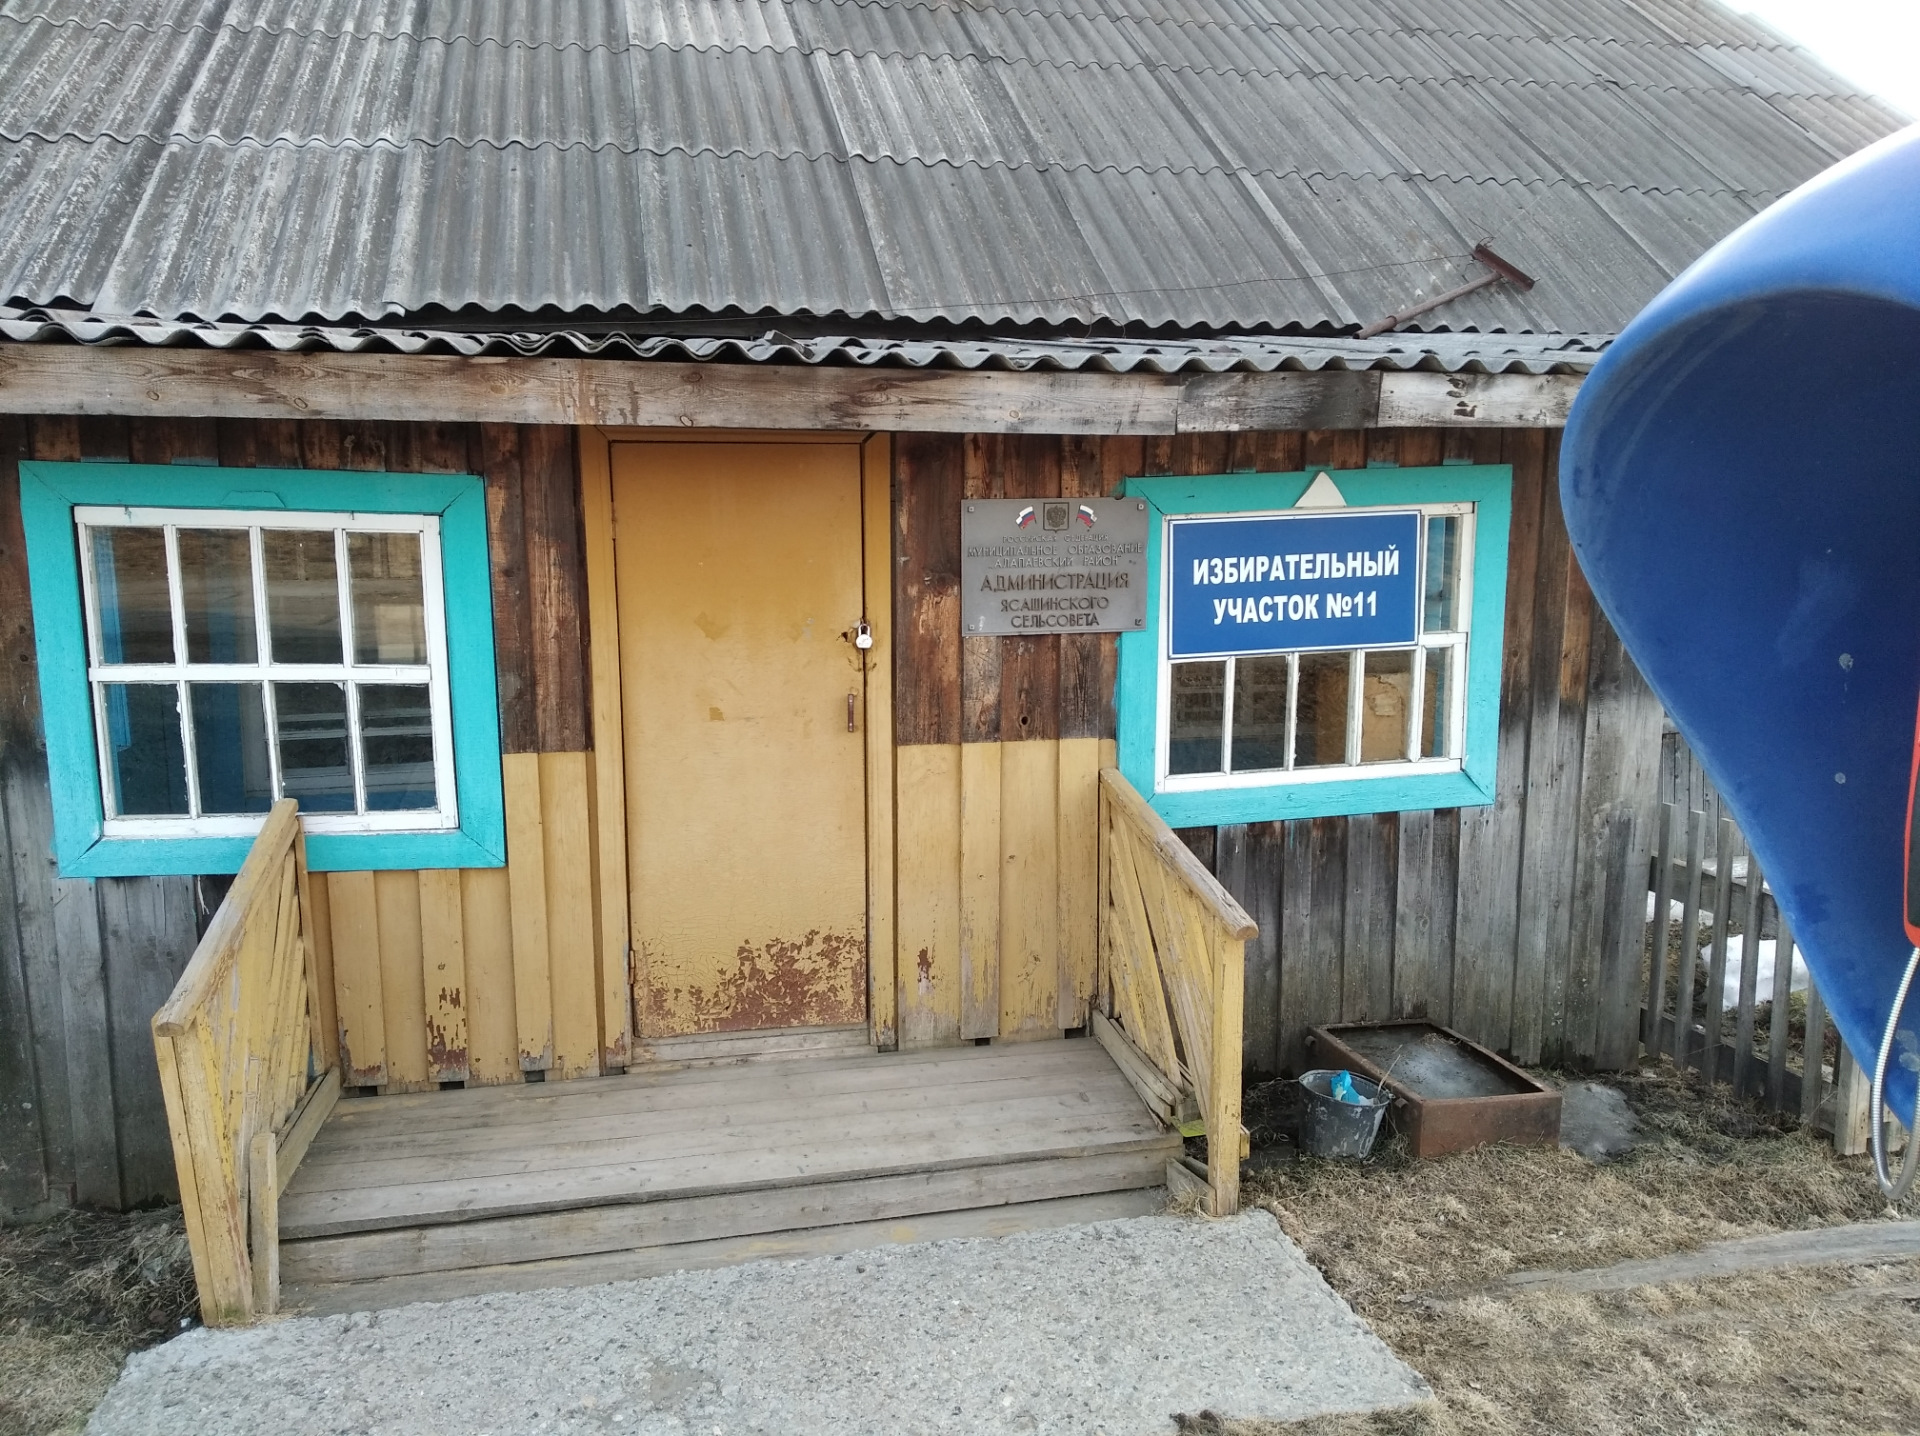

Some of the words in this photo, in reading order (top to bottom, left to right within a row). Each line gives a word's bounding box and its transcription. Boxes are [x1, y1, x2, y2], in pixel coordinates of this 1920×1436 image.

[967, 546, 1057, 557] МУНИЦИПАЛЬНОЕ
[1068, 543, 1143, 555] ОБРАЗОВАНИЕ
[1193, 544, 1399, 585] ИЗБИРАТЕЛЬНЫЙ
[981, 572, 1130, 592] АДМИНИСТРАЦИЯ
[1000, 597, 1109, 612] ЯСАШИНСКОГО
[1213, 593, 1319, 625] УЧАСТОК
[1326, 591, 1377, 619] №11
[1011, 613, 1100, 628] СЕЛЬСОВЕТА
